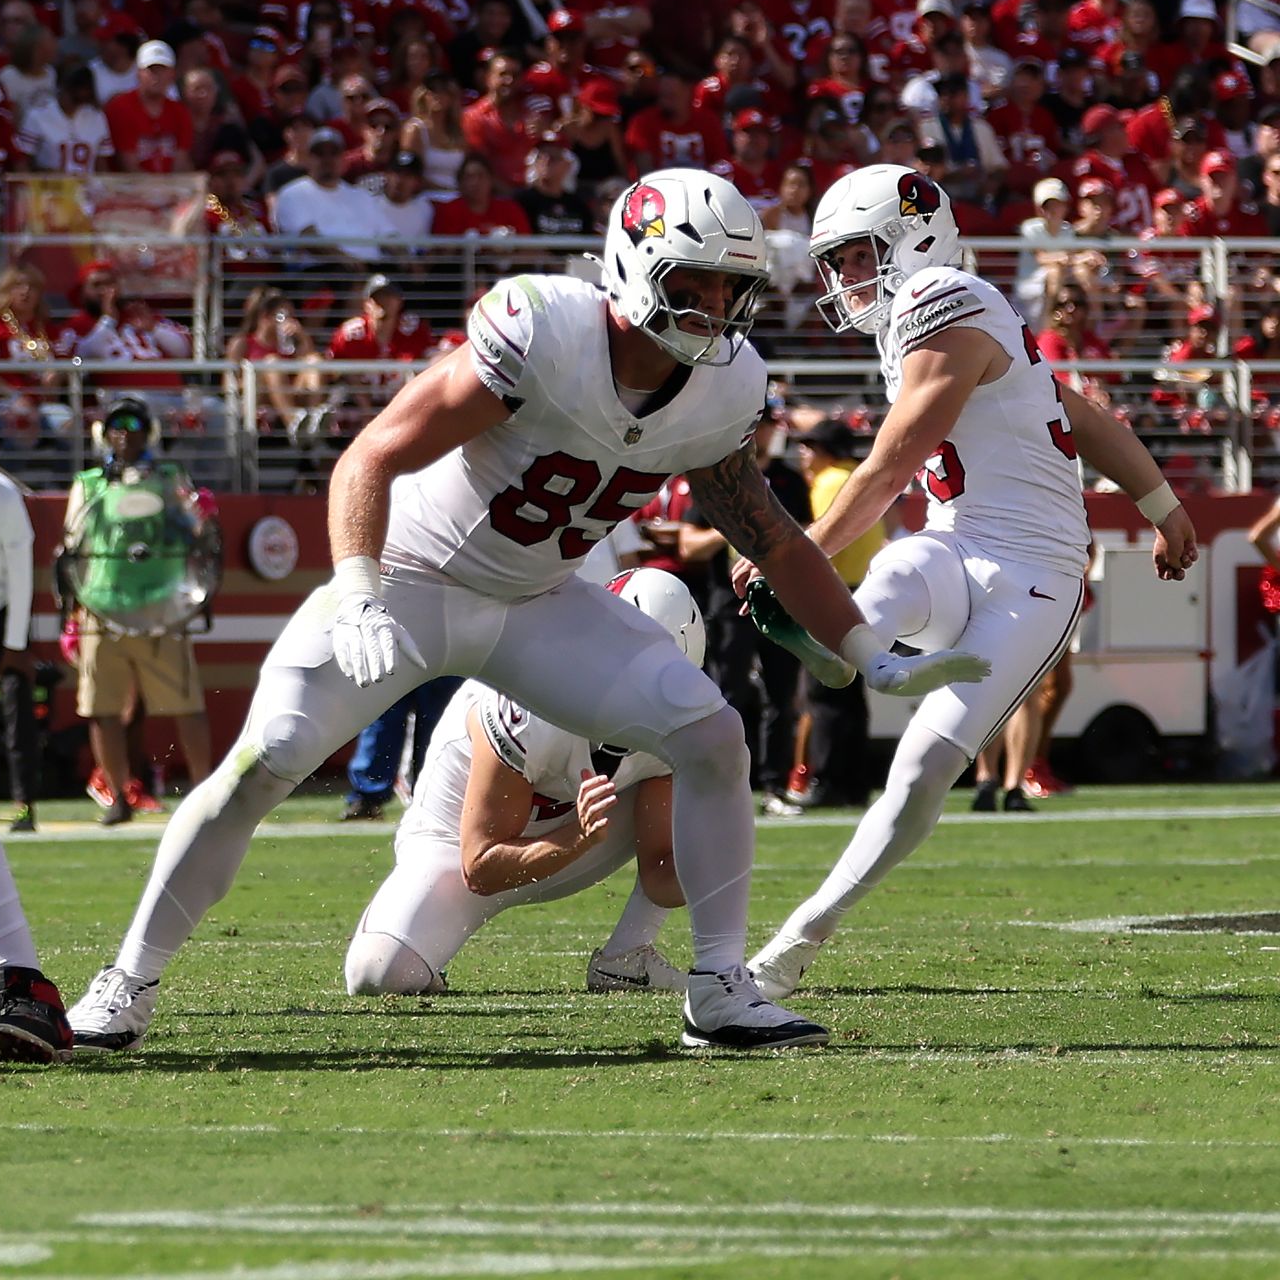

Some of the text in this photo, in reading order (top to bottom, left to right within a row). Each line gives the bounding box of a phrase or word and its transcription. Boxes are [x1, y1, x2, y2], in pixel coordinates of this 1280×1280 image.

[60, 144, 94, 173] 19
[905, 299, 964, 332] CARDINALS
[490, 450, 673, 560] 85
